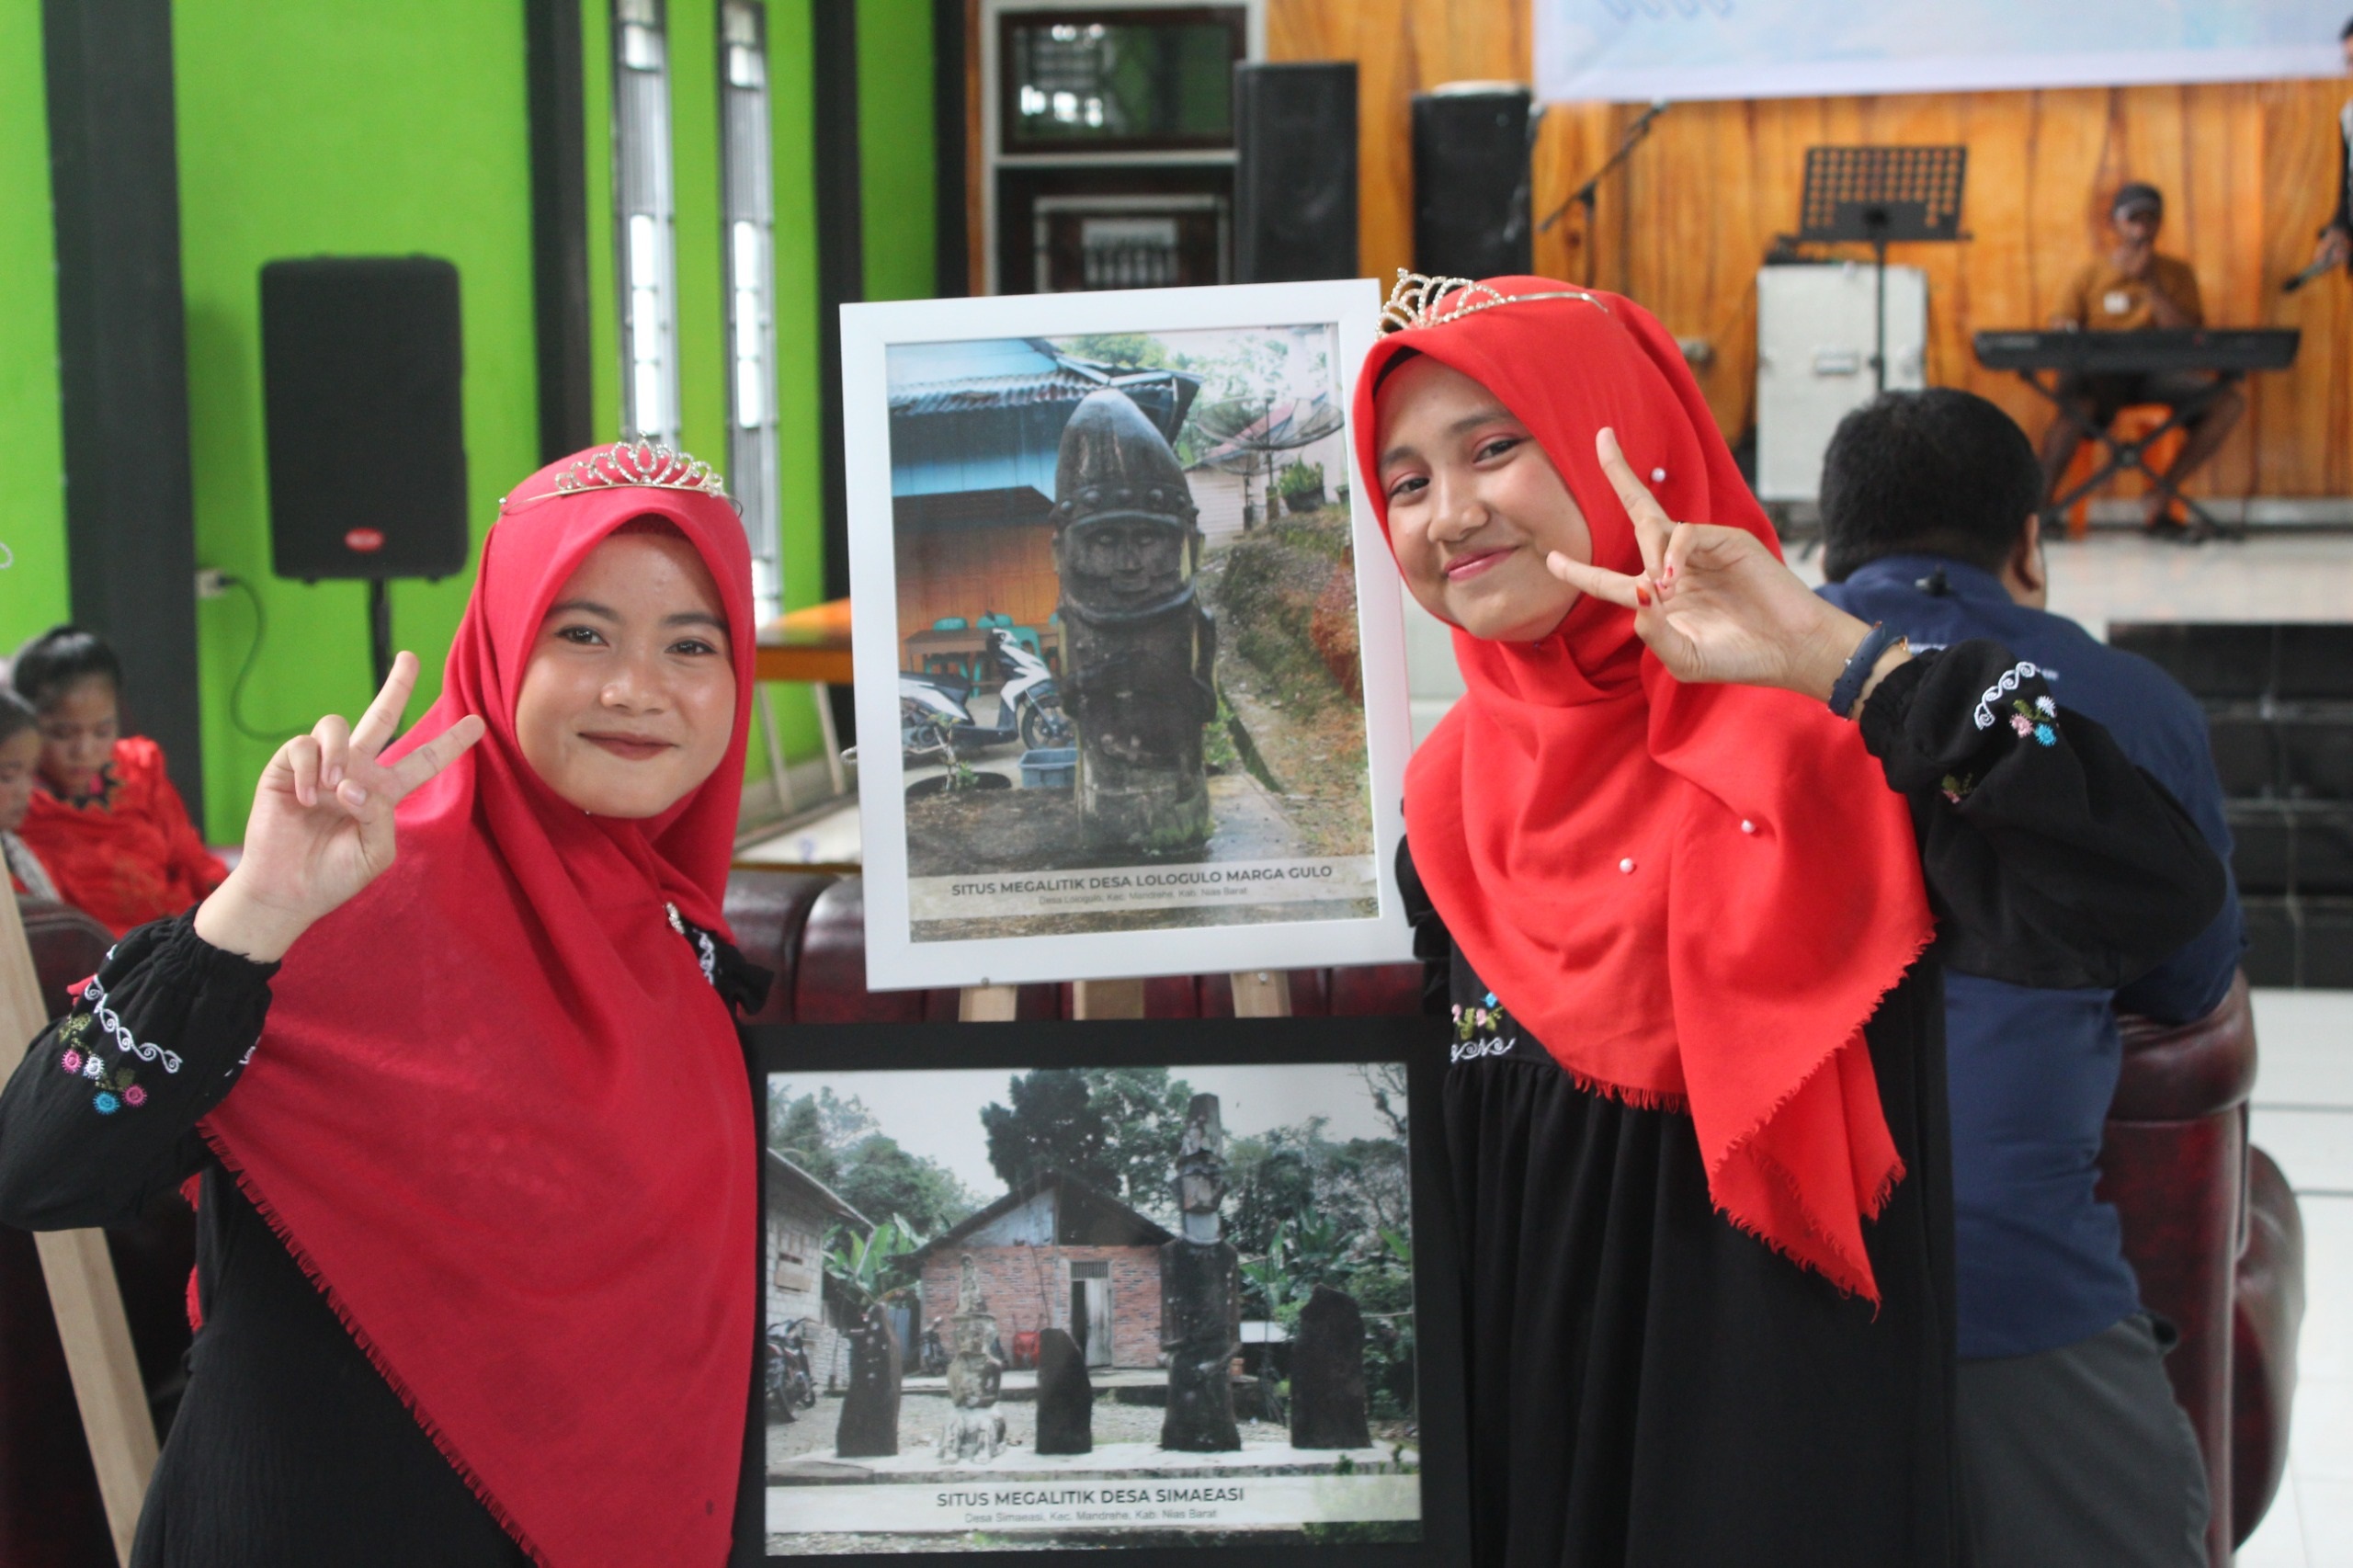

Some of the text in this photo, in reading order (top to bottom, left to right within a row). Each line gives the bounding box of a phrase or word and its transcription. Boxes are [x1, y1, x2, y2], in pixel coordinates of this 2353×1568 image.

[952, 866, 1332, 896] SITUS MEGALITIK DESA LOLOGULO MARGA GULO
[1039, 895, 1063, 905] Desa
[1223, 887, 1247, 896] Barat
[937, 1487, 1244, 1506] SITUS MEGALITIK DESA SIMAEASI
[965, 1512, 992, 1523] Desa
[1162, 1509, 1185, 1519] Nias
[1188, 1508, 1217, 1519] Barat
